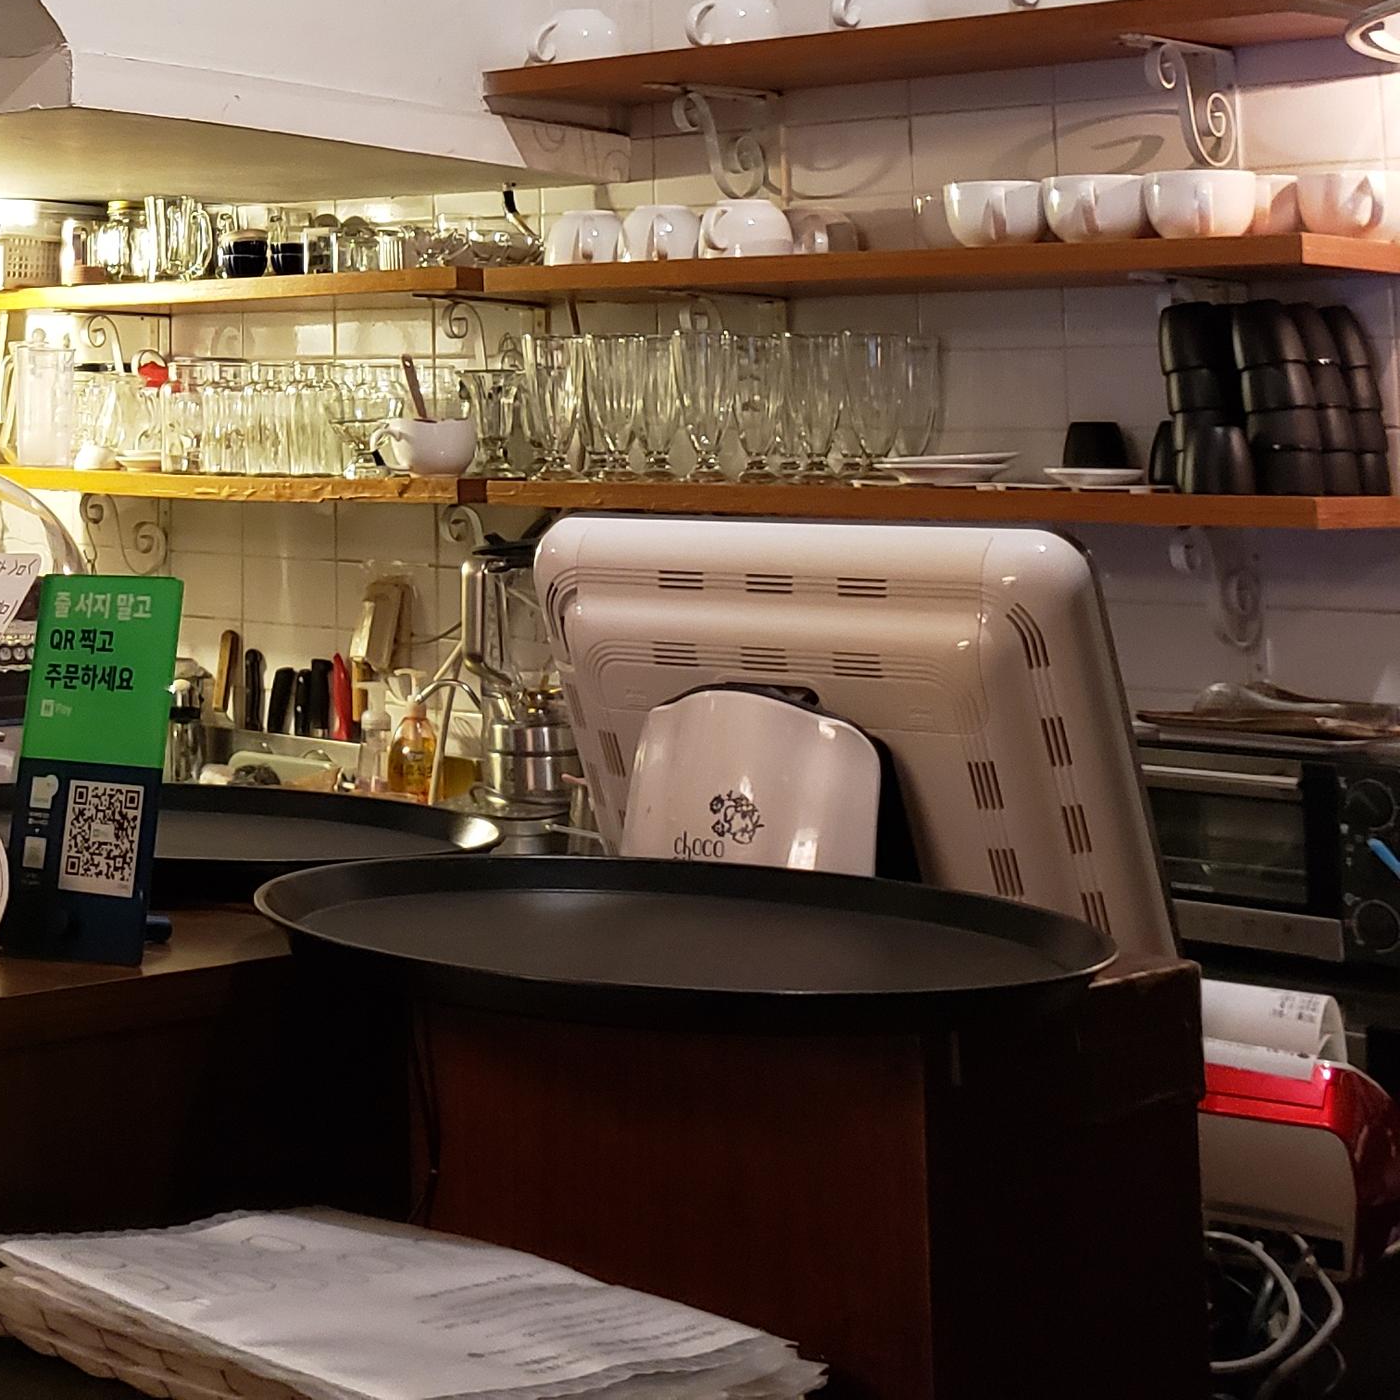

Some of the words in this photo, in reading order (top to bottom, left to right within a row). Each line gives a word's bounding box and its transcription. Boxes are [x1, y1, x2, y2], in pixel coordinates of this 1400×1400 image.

[55, 592, 72, 618] 줄
[75, 593, 111, 619] 서지
[117, 594, 152, 621] 말고
[50, 629, 76, 651] QR
[79, 629, 114, 655] 찍고
[45, 664, 134, 692] 주문하세요
[673, 830, 725, 860] choco
